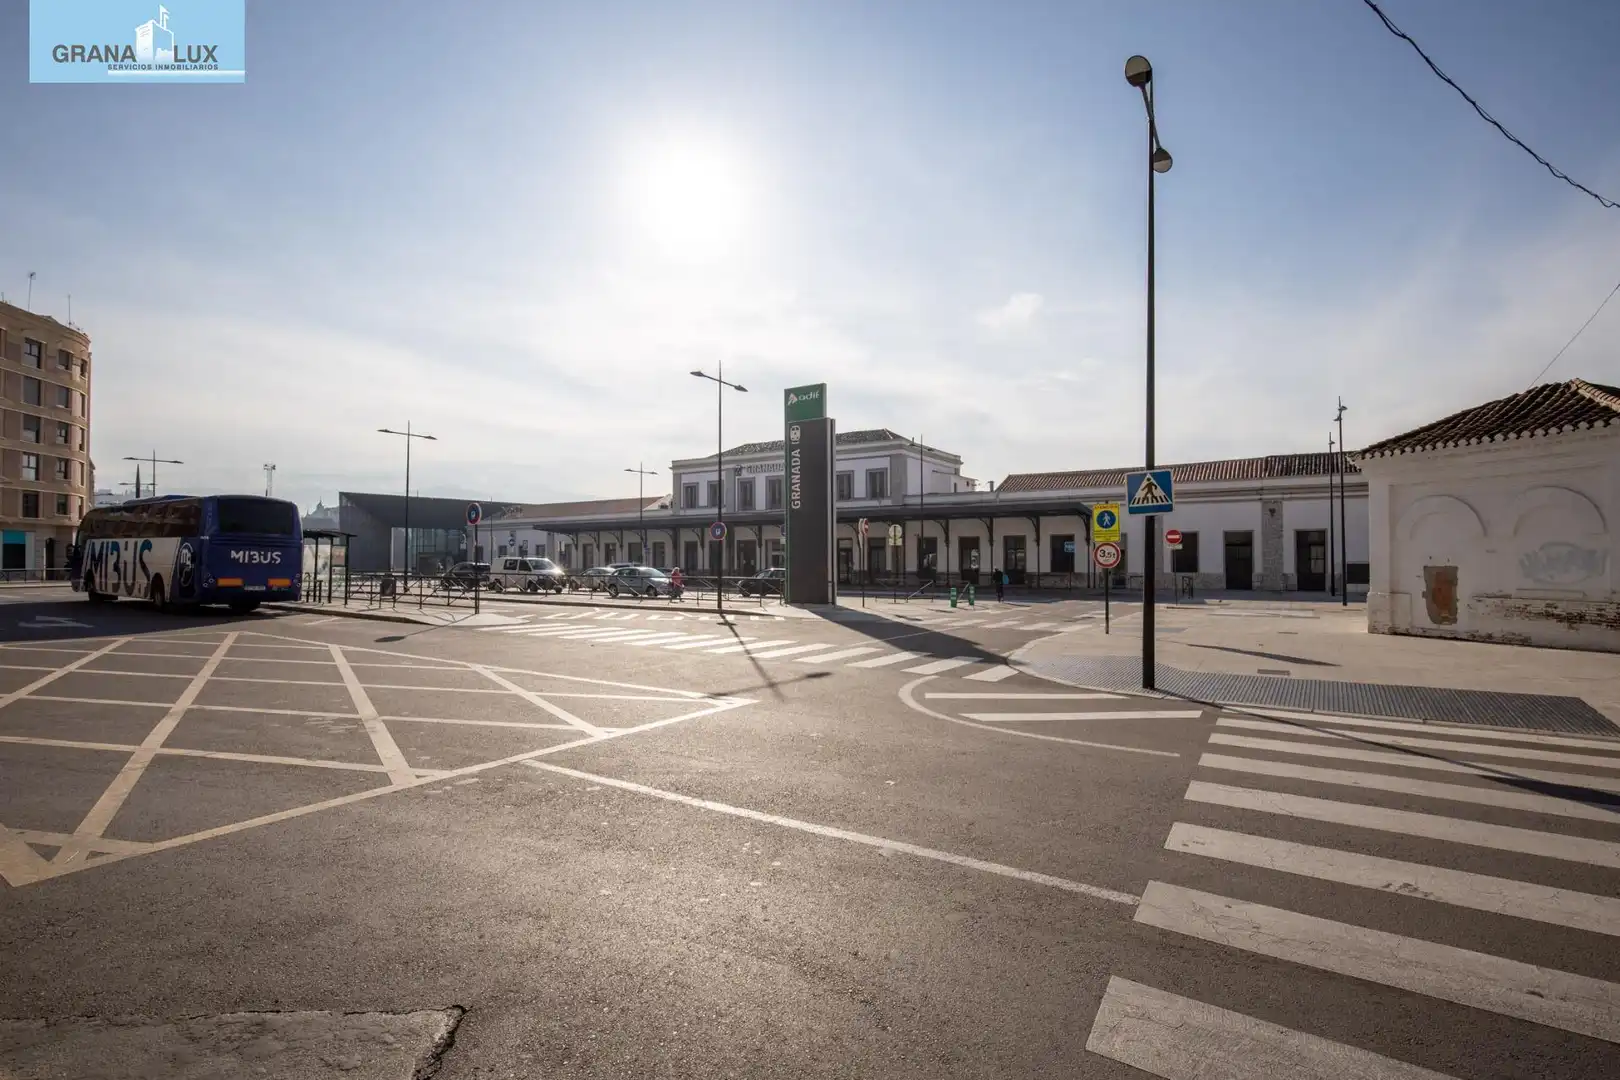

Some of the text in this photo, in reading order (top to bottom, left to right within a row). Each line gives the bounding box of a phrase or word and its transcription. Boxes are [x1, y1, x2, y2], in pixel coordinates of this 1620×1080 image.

[798, 390, 820, 401] adif
[791, 448, 801, 509] GRANADA
[230, 550, 282, 564] MIBUS
